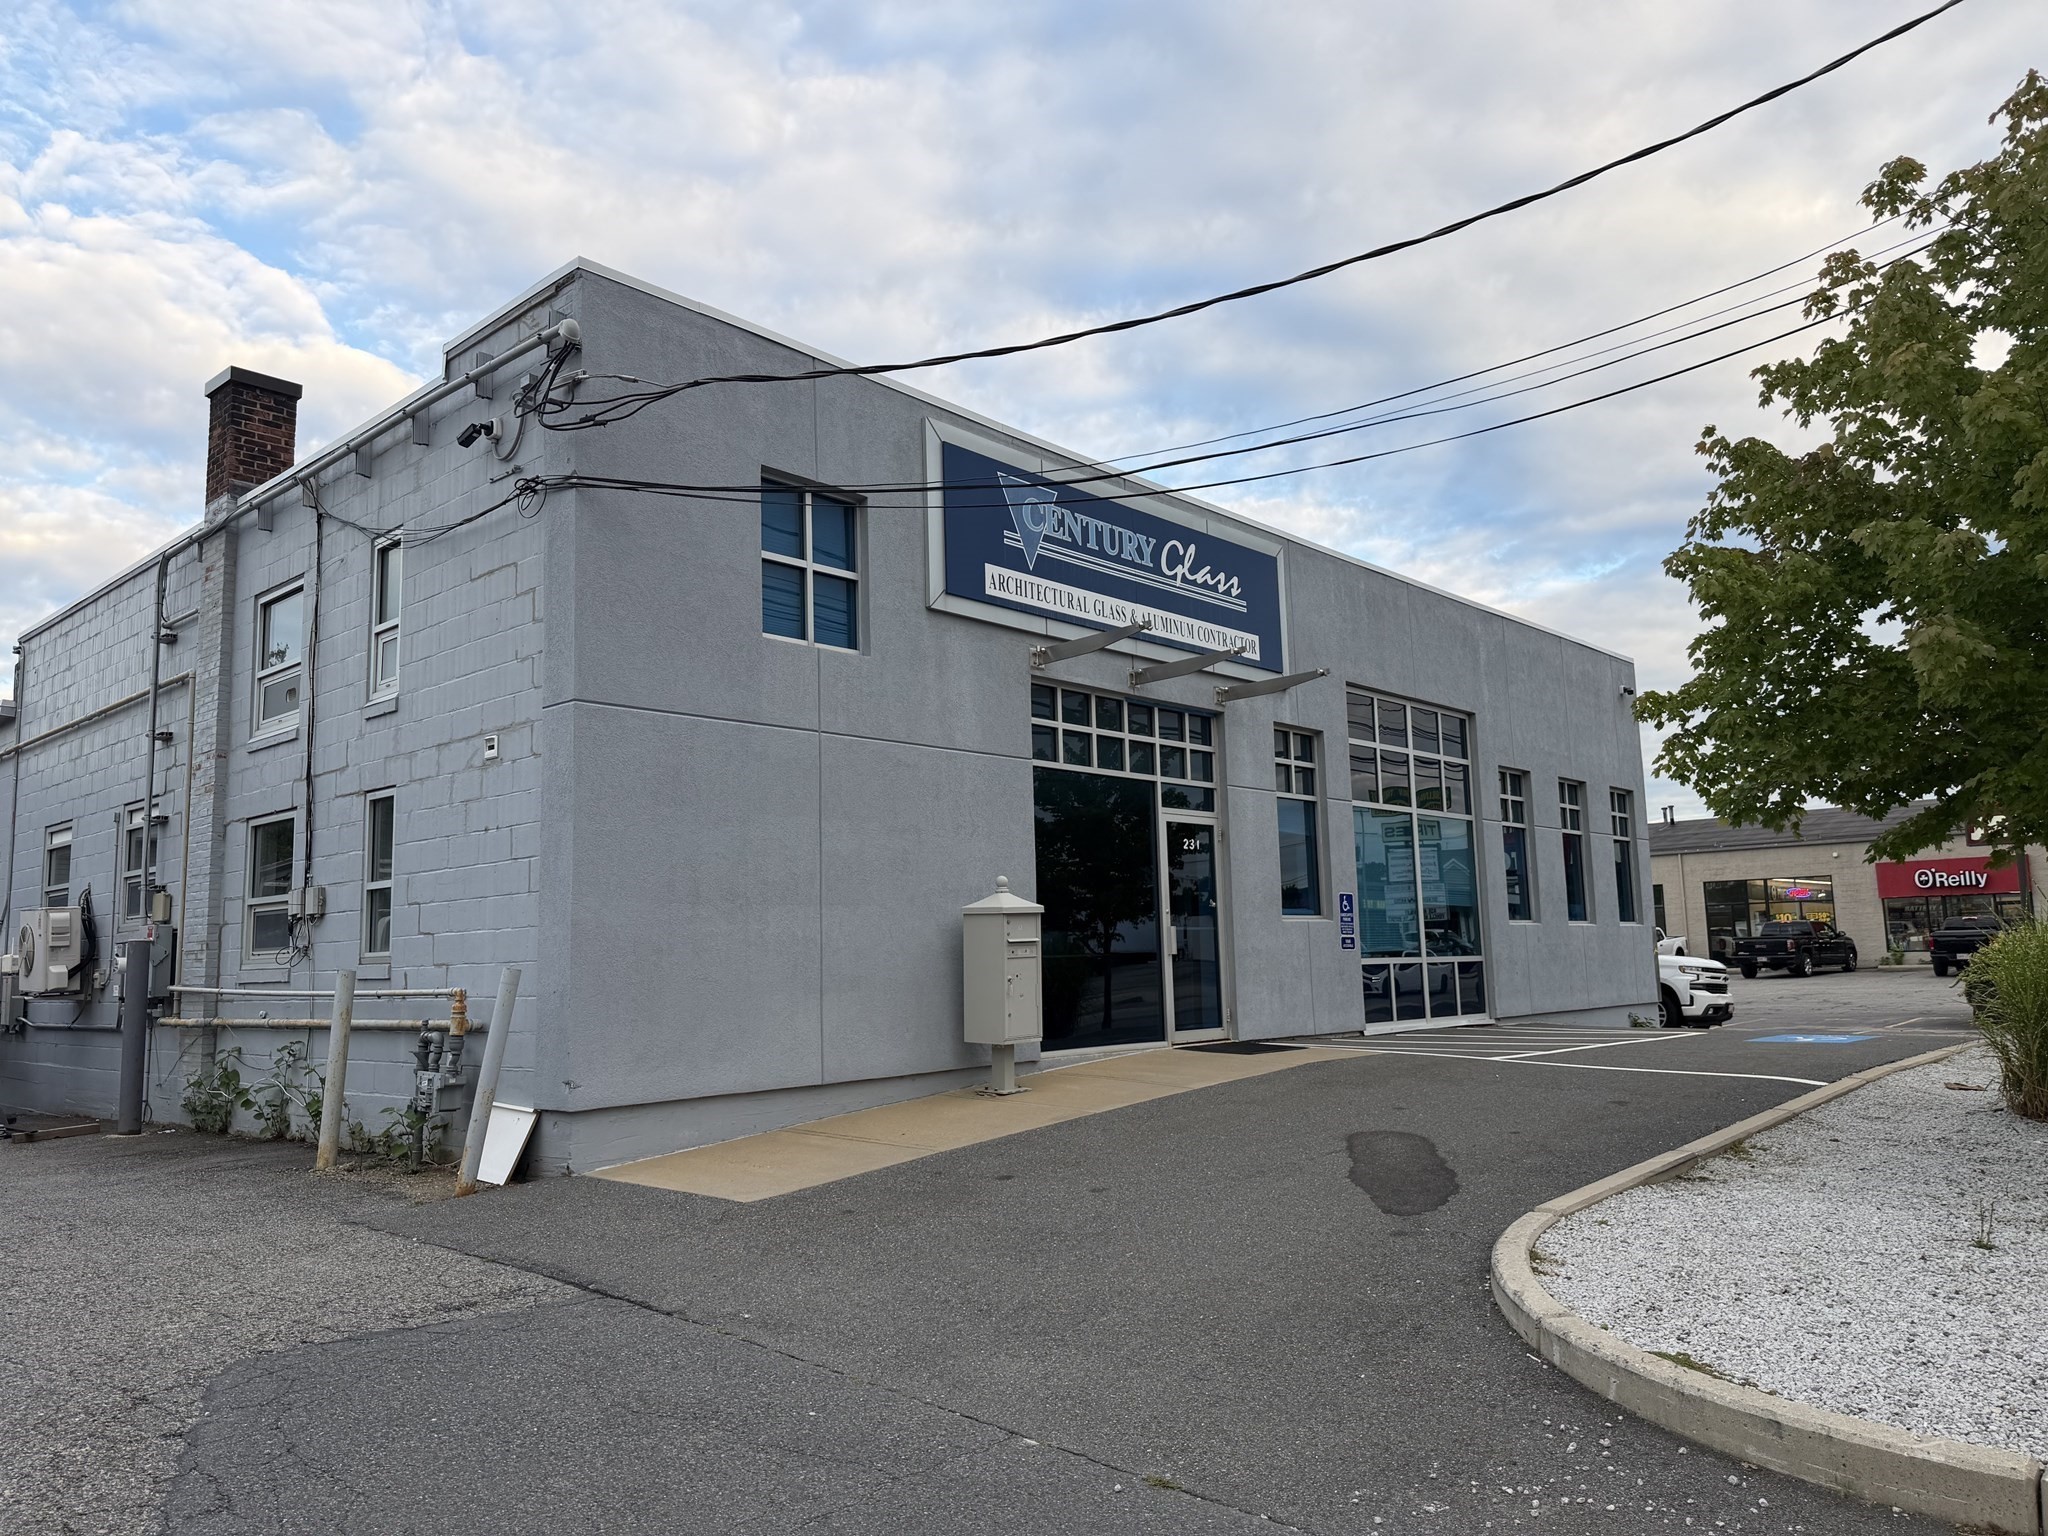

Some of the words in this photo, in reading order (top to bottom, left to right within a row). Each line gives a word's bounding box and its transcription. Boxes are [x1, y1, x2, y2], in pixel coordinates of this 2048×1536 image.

[1022, 497, 1157, 567] CENTURY
[1160, 539, 1242, 598] Glass
[988, 571, 1091, 614] ARCHITECTURAL
[1093, 598, 1127, 623] GLASS
[1130, 608, 1138, 626] &
[1183, 838, 1200, 850] 231
[1914, 868, 1988, 888] O'Reilly
